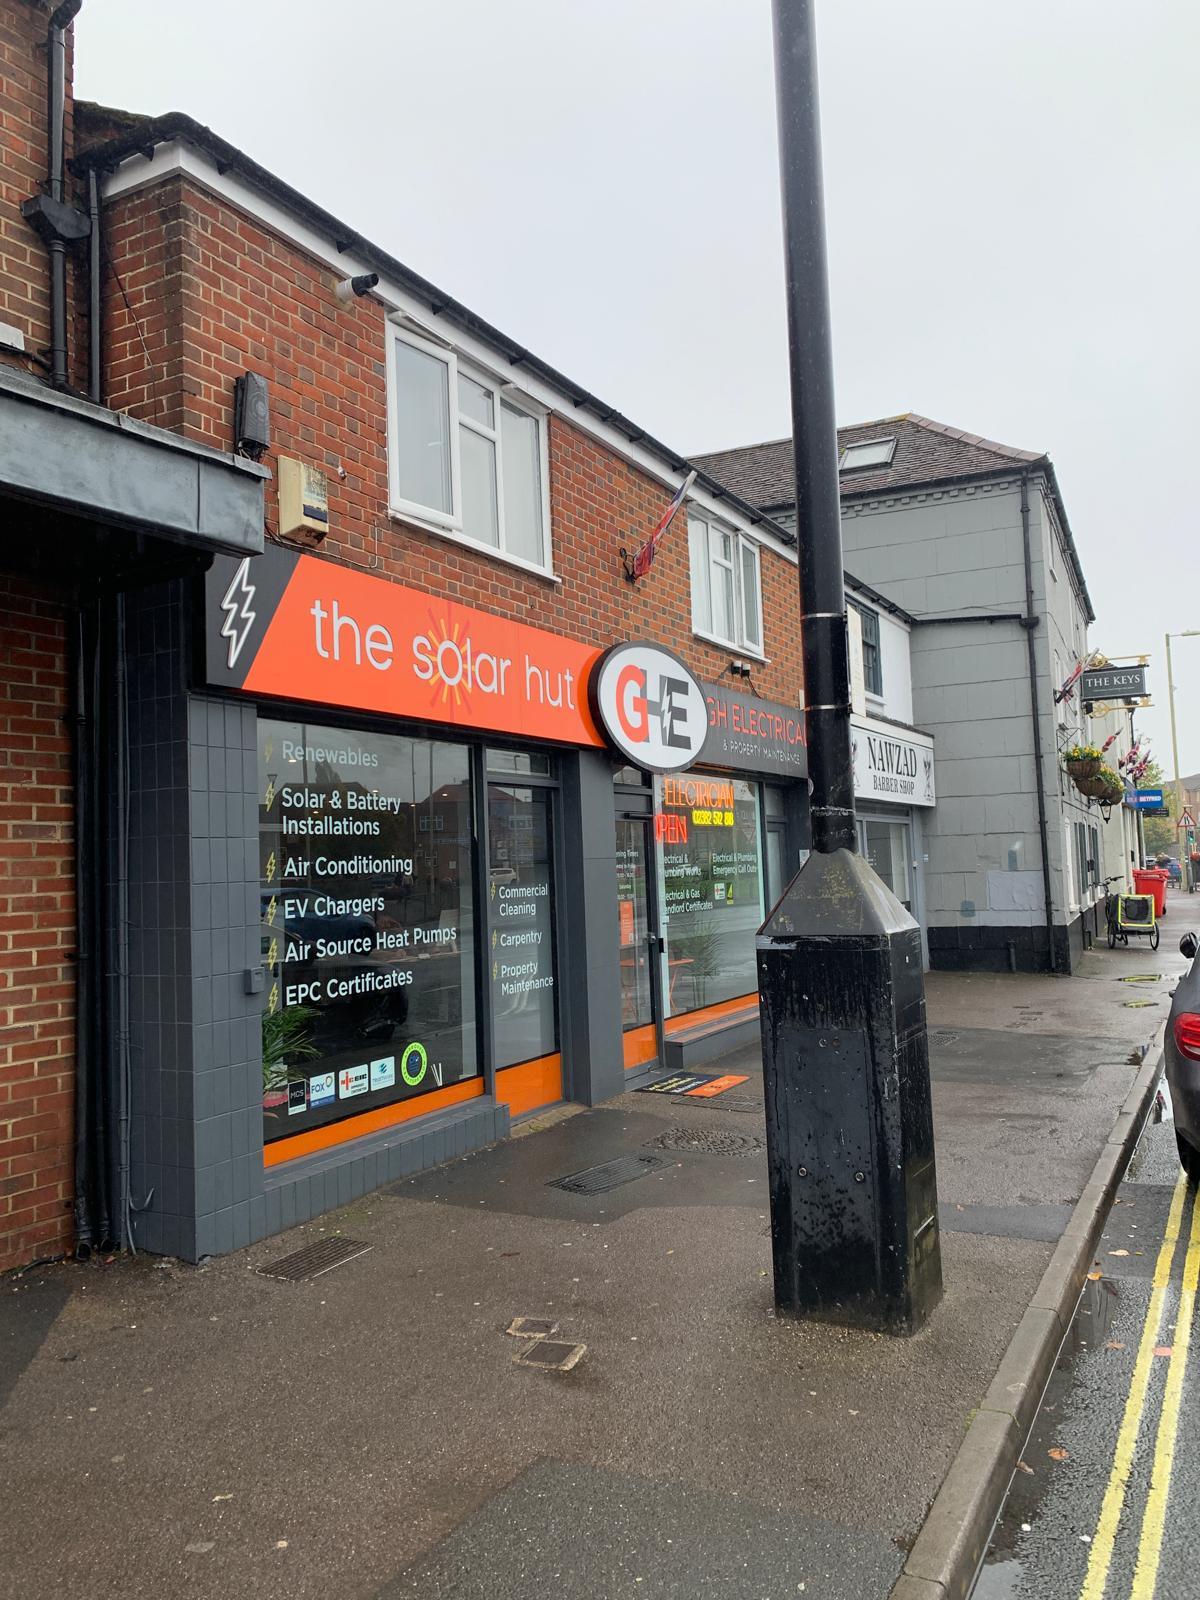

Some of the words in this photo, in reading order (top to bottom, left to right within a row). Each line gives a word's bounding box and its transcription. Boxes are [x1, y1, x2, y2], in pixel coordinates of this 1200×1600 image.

[310, 599, 394, 671] the
[412, 634, 512, 696] solar
[524, 654, 576, 710] hut
[1086, 677, 1110, 688] THE
[1113, 674, 1140, 686] KEYS
[282, 740, 378, 767] Renewables
[723, 739, 728, 751] &
[730, 740, 761, 757] PROPERTY
[763, 747, 800, 765] MAINTENANCE
[867, 737, 917, 778] NAWZAD
[664, 778, 735, 809] ELECTRICIAN
[873, 774, 899, 793] BARBER
[899, 780, 915, 795] SHOP
[282, 788, 326, 809] Solar
[330, 789, 342, 810] &
[347, 791, 401, 815] Battery
[282, 815, 380, 836] Installations
[284, 857, 310, 877] Air
[315, 855, 413, 878] Conditioning
[664, 854, 684, 864] ectrical
[664, 867, 684, 878] umbing
[499, 884, 548, 899] Commercial
[665, 890, 684, 900] ectrical
[690, 889, 700, 898] Gas
[284, 898, 309, 919] EV
[314, 896, 385, 920] Chargers
[499, 902, 536, 917] Cleaning
[665, 903, 684, 914] andlord
[686, 901, 713, 912] Certificates
[284, 942, 311, 963] Air
[316, 935, 371, 959] Source
[376, 930, 409, 950] Heat
[413, 927, 457, 948] Pumps
[500, 930, 542, 947] Carpentry
[501, 961, 538, 979] Property
[286, 981, 321, 1006] EPC
[326, 969, 413, 999] Certificates
[501, 975, 554, 996] Maintenance
[290, 1089, 304, 1100] MCS
[311, 1082, 325, 1094] FOX
